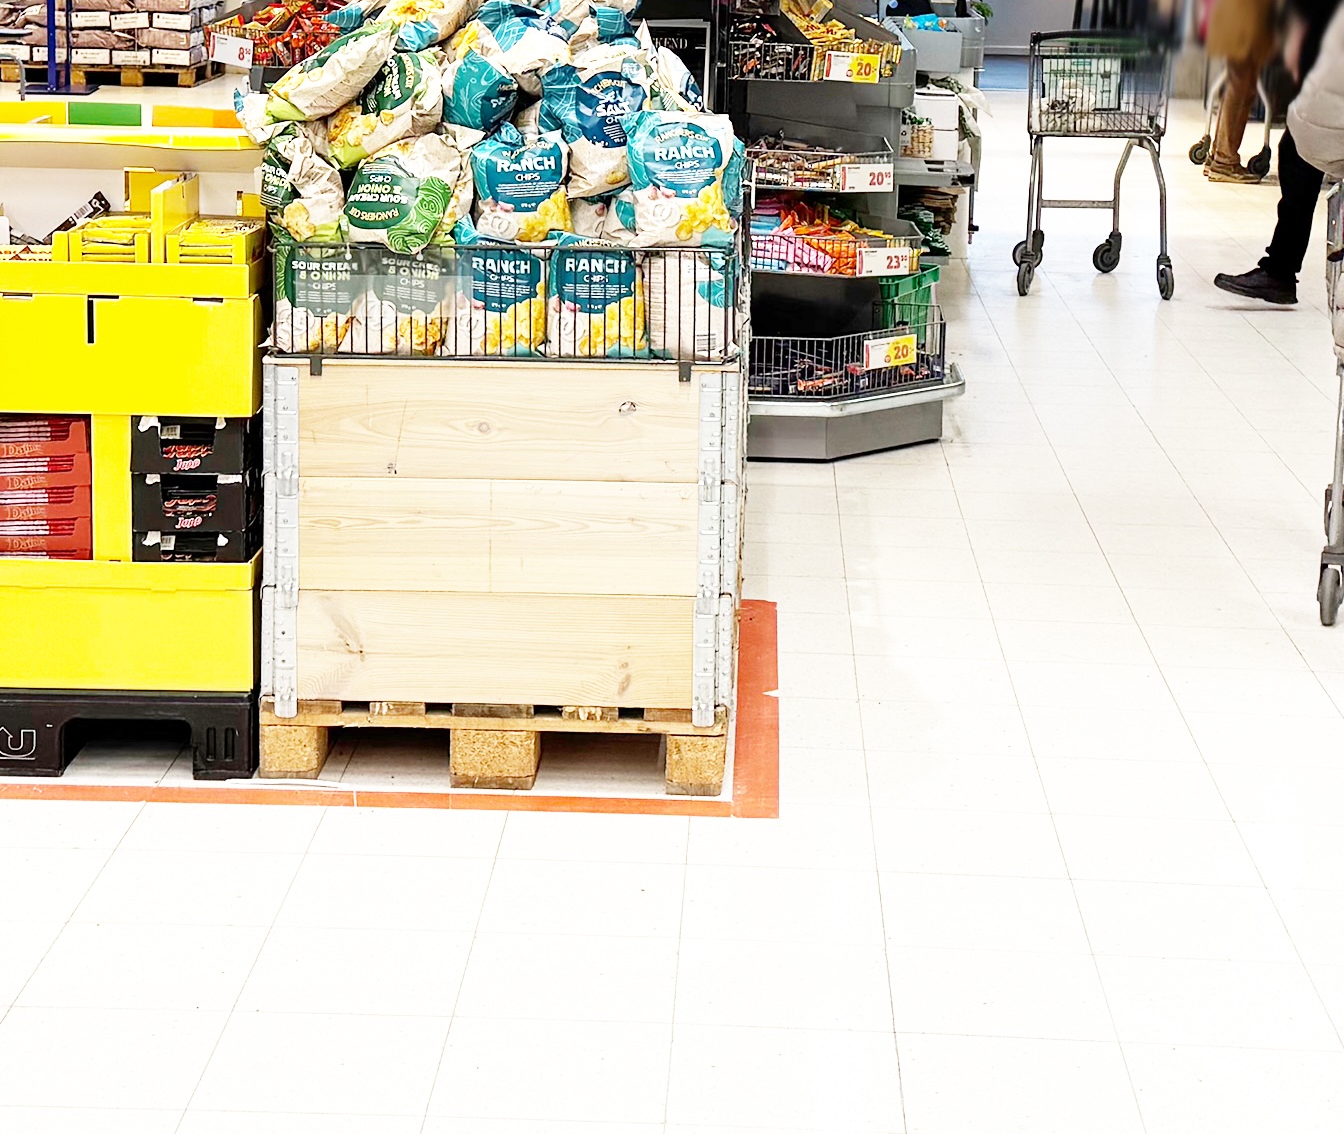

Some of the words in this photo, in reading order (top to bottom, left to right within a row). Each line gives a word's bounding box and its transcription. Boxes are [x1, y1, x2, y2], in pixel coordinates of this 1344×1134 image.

[596, 102, 631, 116] SALT
[654, 145, 716, 161] RANCH
[497, 156, 556, 173] RANCH
[674, 159, 700, 169] CHIPS
[515, 172, 541, 181] CHIPS
[869, 171, 884, 186] 20
[381, 193, 409, 204] SOUR
[292, 260, 321, 270] SOUR
[472, 256, 531, 274] RANCH
[565, 258, 627, 274] RANCH
[886, 255, 901, 269] 23
[310, 270, 351, 281] ONION
